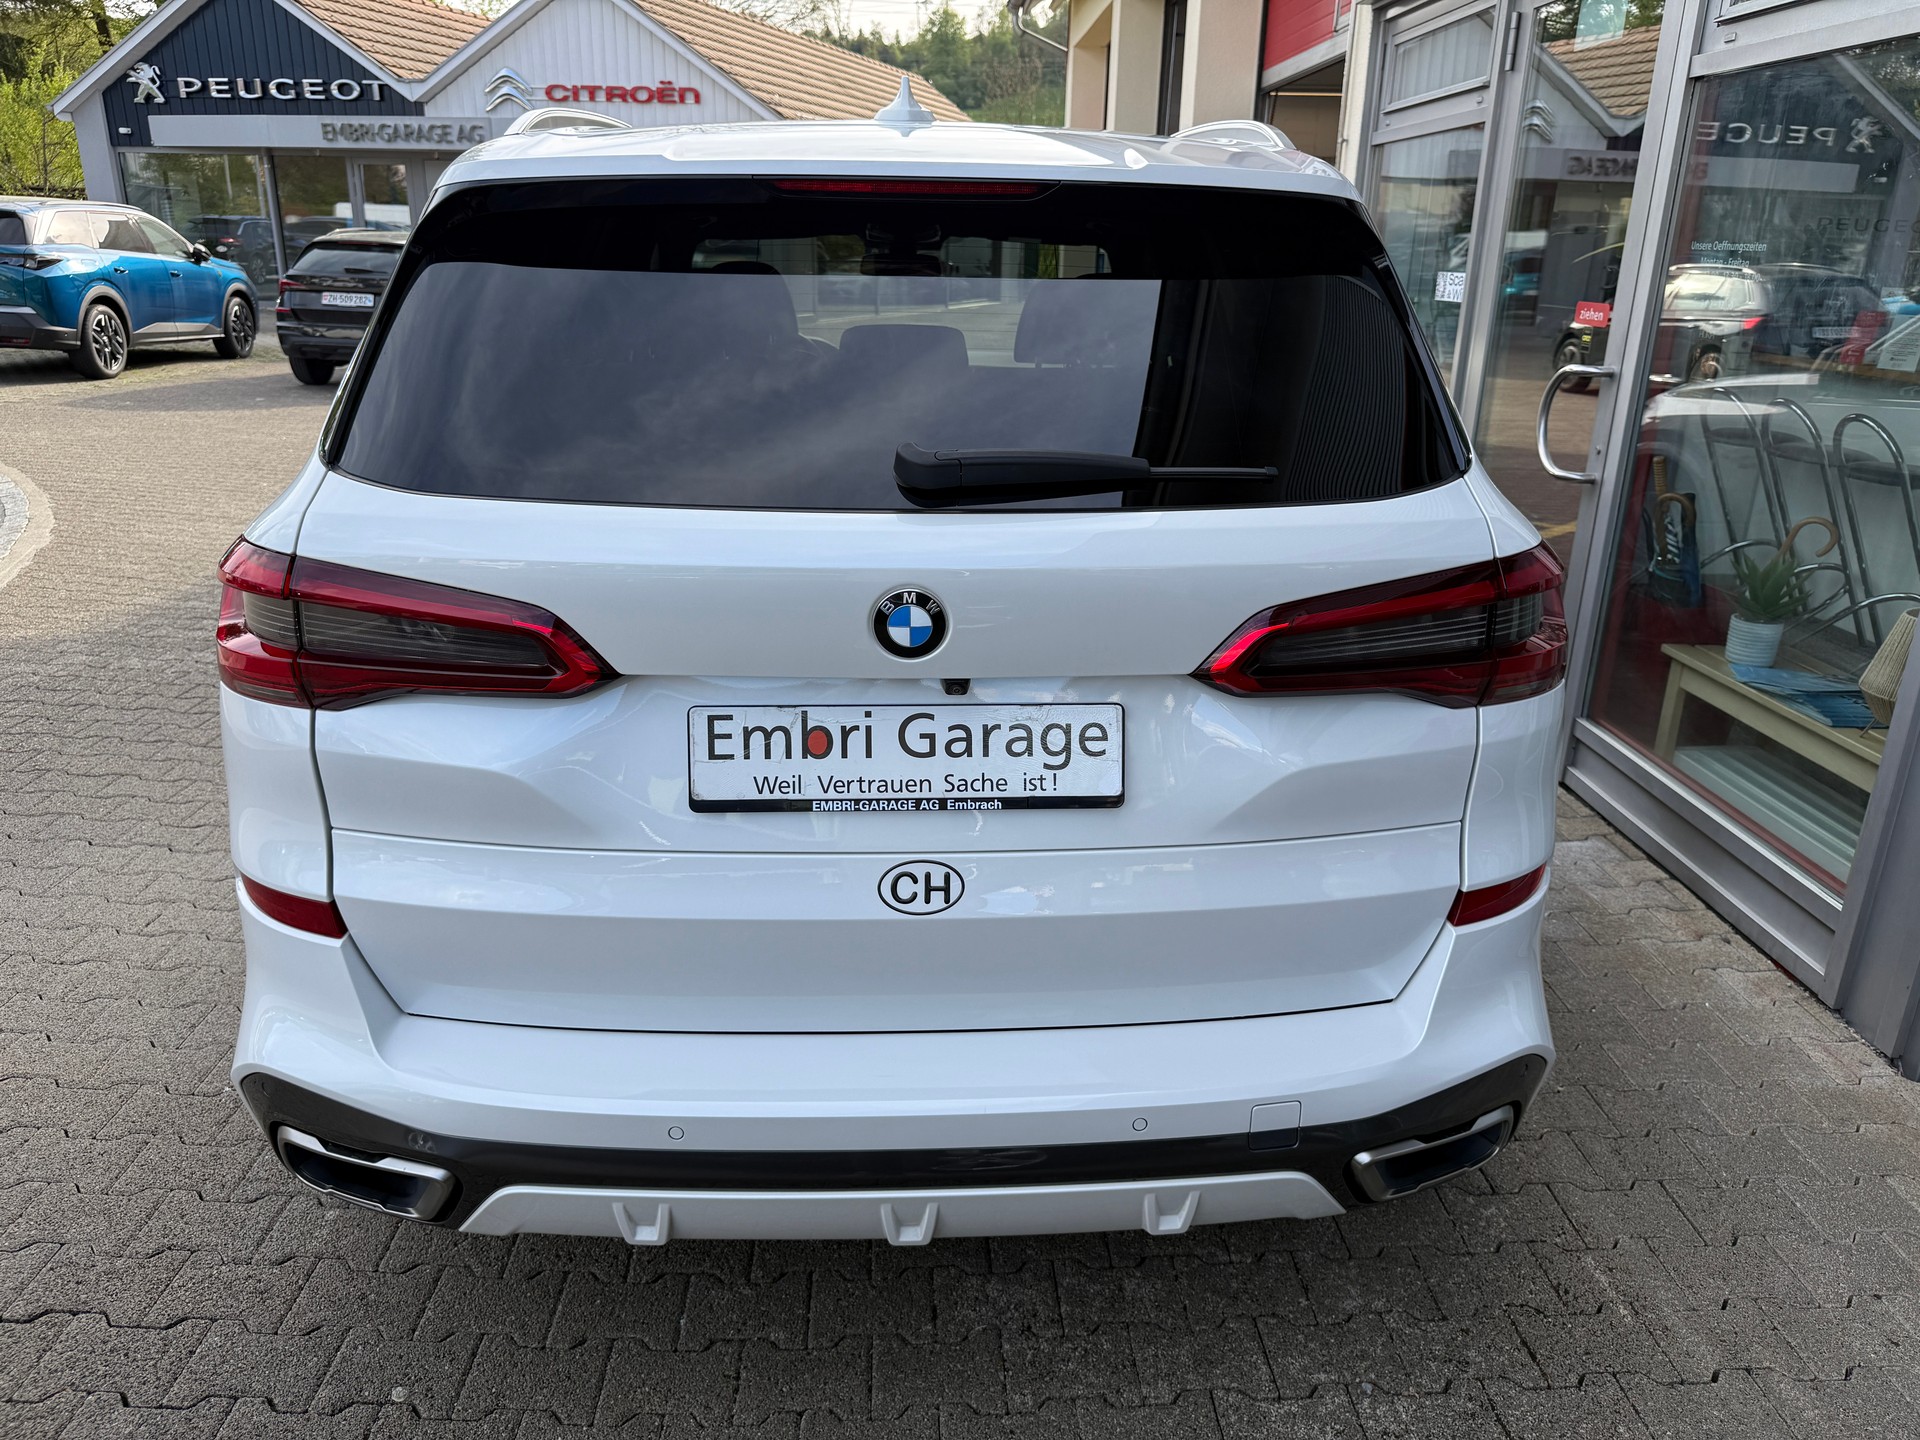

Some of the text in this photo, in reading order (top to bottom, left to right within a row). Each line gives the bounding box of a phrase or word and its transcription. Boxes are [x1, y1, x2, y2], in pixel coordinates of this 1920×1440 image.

[176, 77, 386, 101] PEUGEOT
[544, 80, 702, 105] CITROËN
[320, 121, 486, 144] EMBRI-GARAGE AG
[1691, 240, 1767, 254] Unsere Oeffnungszeiten
[1579, 307, 1604, 321] ziehen
[879, 592, 941, 616] BMW
[706, 710, 1109, 771] Embri Garage
[753, 774, 802, 796] Weil
[816, 774, 933, 795] Vertrauen
[943, 772, 1008, 794] Sache
[811, 798, 1003, 812] EMBRI-GARAGE AG Embrach
[890, 870, 952, 905] CH
